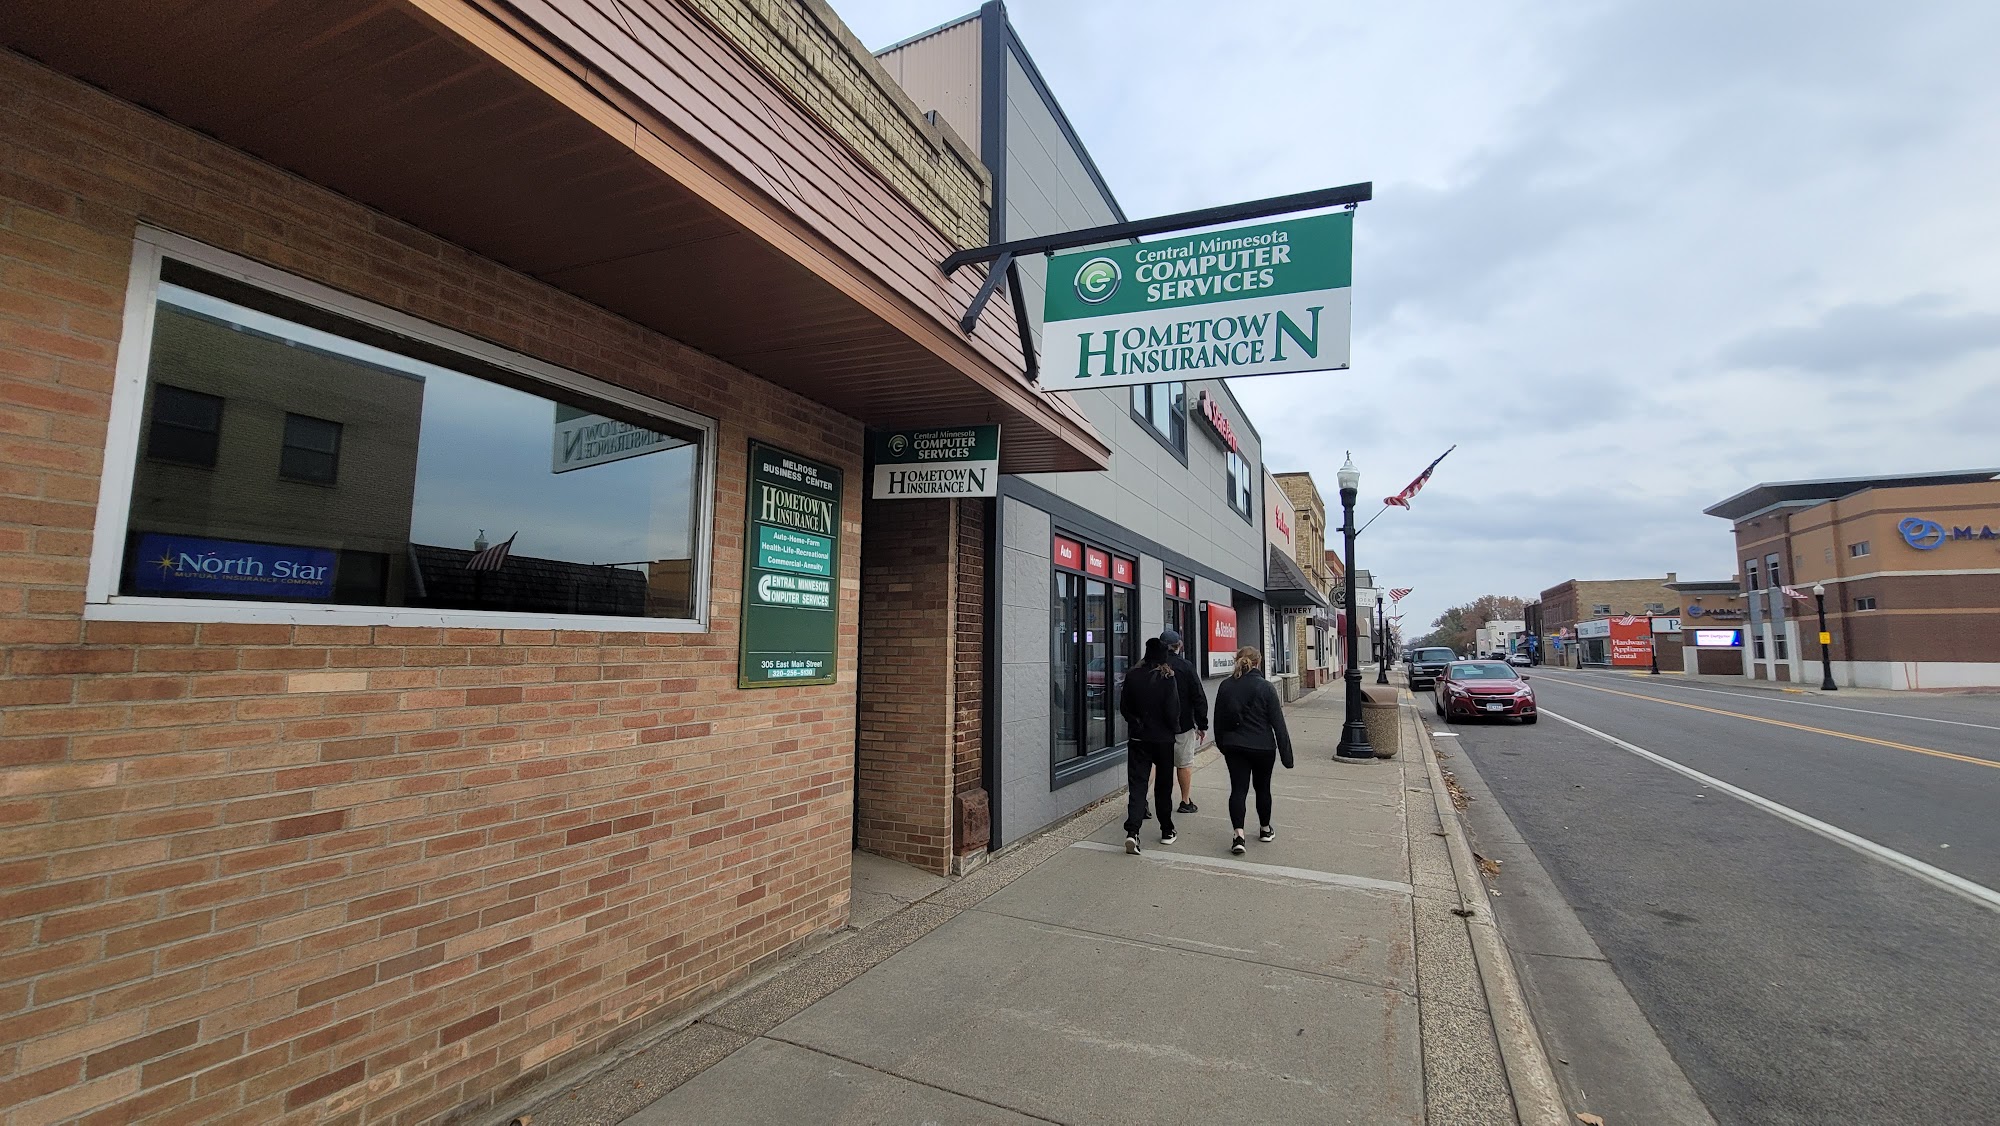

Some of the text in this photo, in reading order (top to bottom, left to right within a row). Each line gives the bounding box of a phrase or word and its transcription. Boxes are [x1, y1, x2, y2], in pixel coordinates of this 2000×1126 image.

[1136, 230, 1288, 264] Central Minnesota
[1136, 244, 1291, 283] COMPUTER
[1147, 269, 1274, 302] SERVICES
[1075, 306, 1324, 378] HOMETOWN
[1120, 340, 1264, 375] INSURANCE
[914, 430, 975, 440] Central Minnesota
[914, 437, 976, 449] COMPUTER
[918, 448, 969, 459] SERVICES
[783, 459, 817, 477] MELROSE
[763, 463, 833, 491] BUSINESS CENTER
[888, 468, 987, 494] HOMETOWN
[907, 481, 964, 493] INSURANCE
[761, 485, 832, 534] HOMETOWN
[777, 508, 819, 531] INSURANCE
[1061, 545, 1072, 559] Auto
[176, 552, 327, 580] North Star
[1090, 555, 1102, 568] Home
[1117, 564, 1125, 575] Life
[175, 572, 218, 580] MUTUAL
[223, 575, 277, 583] INSURANCE
[798, 579, 829, 593] MINNESOTA
[802, 594, 829, 606] SERVICES
[806, 660, 822, 668] Street
